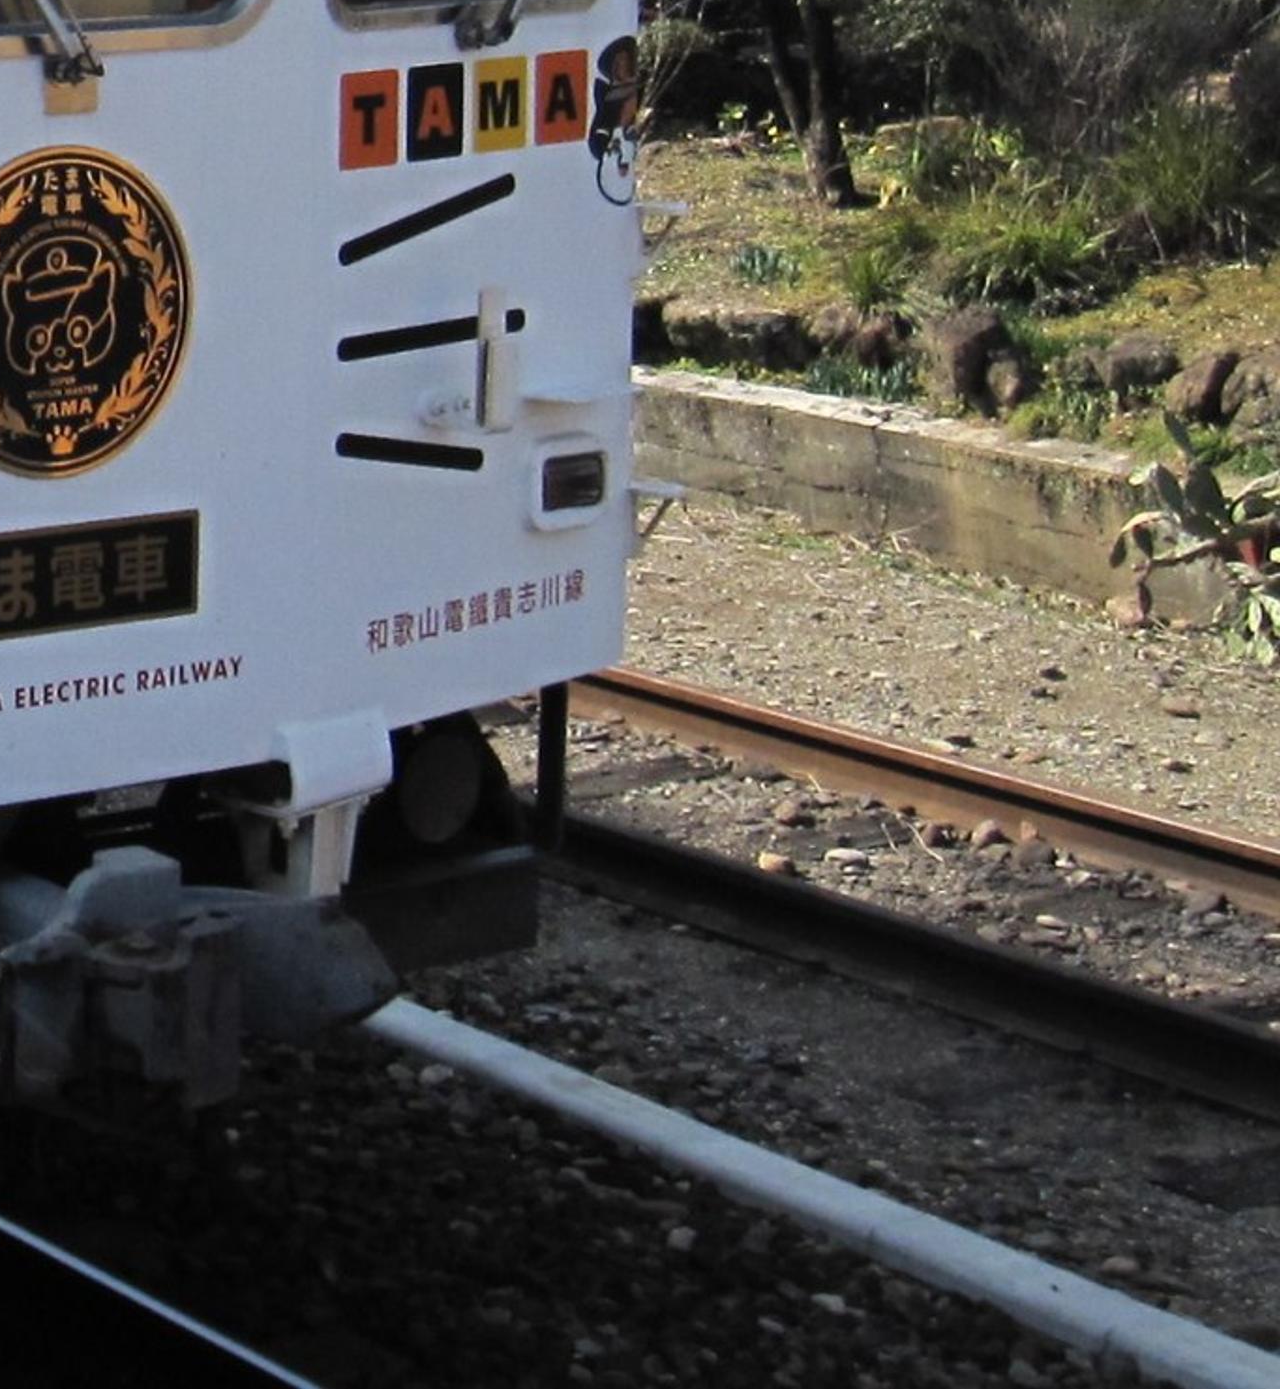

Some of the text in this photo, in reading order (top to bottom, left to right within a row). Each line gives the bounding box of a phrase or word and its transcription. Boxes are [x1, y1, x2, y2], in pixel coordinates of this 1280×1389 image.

[352, 72, 578, 146] TAMA
[32, 397, 94, 419] TAMA
[14, 673, 126, 710] ELECTRIC
[136, 655, 243, 692] RAILWAY
